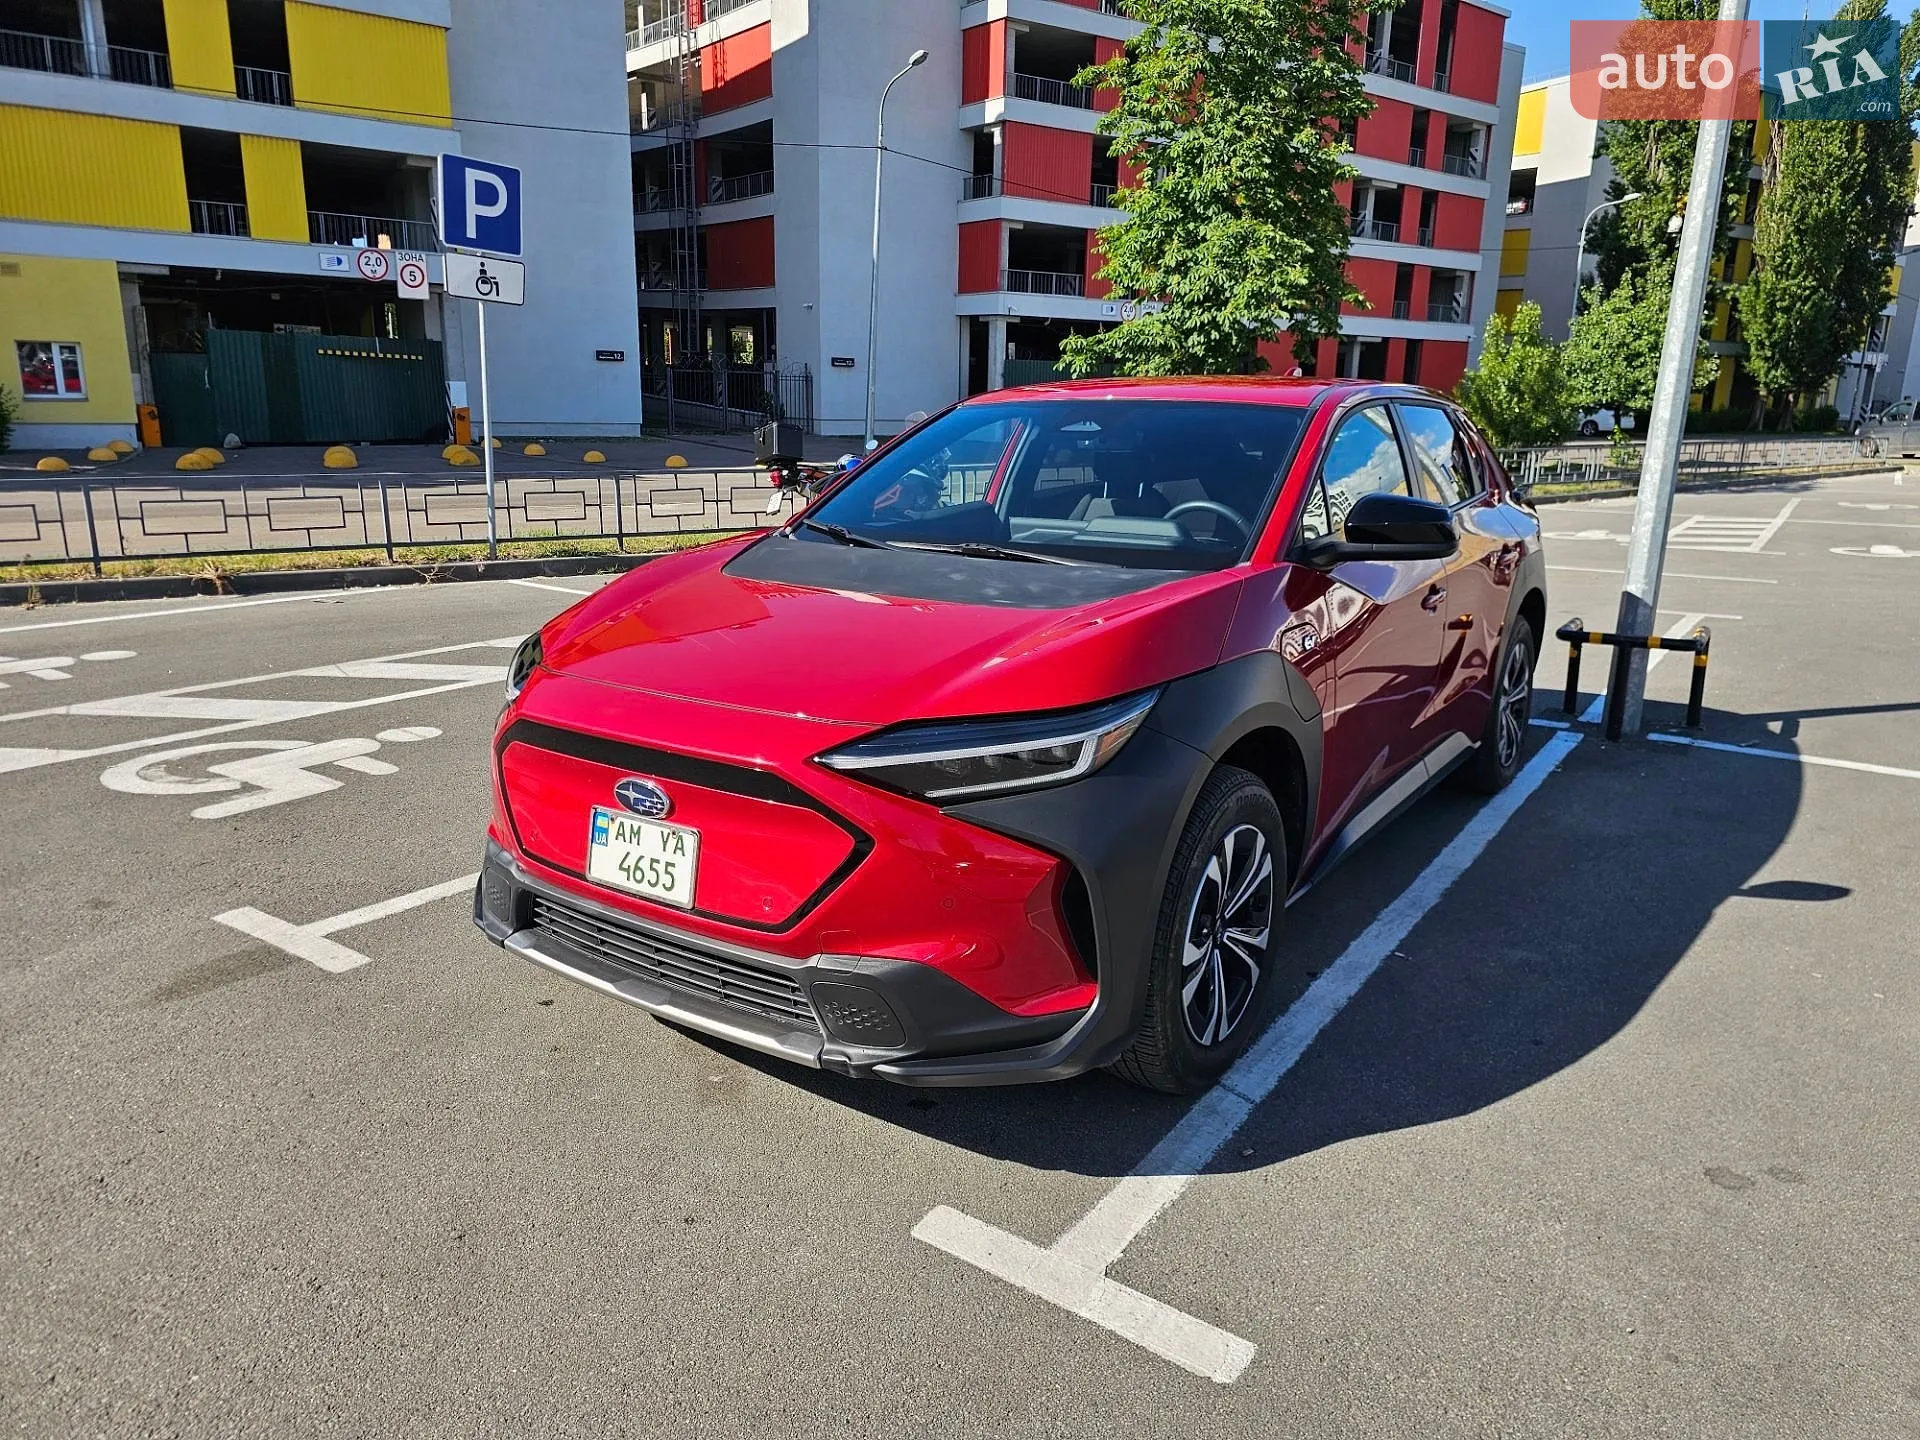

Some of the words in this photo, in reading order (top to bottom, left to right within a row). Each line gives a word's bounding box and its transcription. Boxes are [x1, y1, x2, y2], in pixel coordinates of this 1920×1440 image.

[465, 167, 508, 239] P
[399, 252, 425, 263] ЗОНА
[409, 271, 417, 282] 5
[595, 832, 607, 845] UA
[615, 821, 642, 846] AM
[661, 830, 685, 856] YA
[618, 851, 676, 892] 4655
